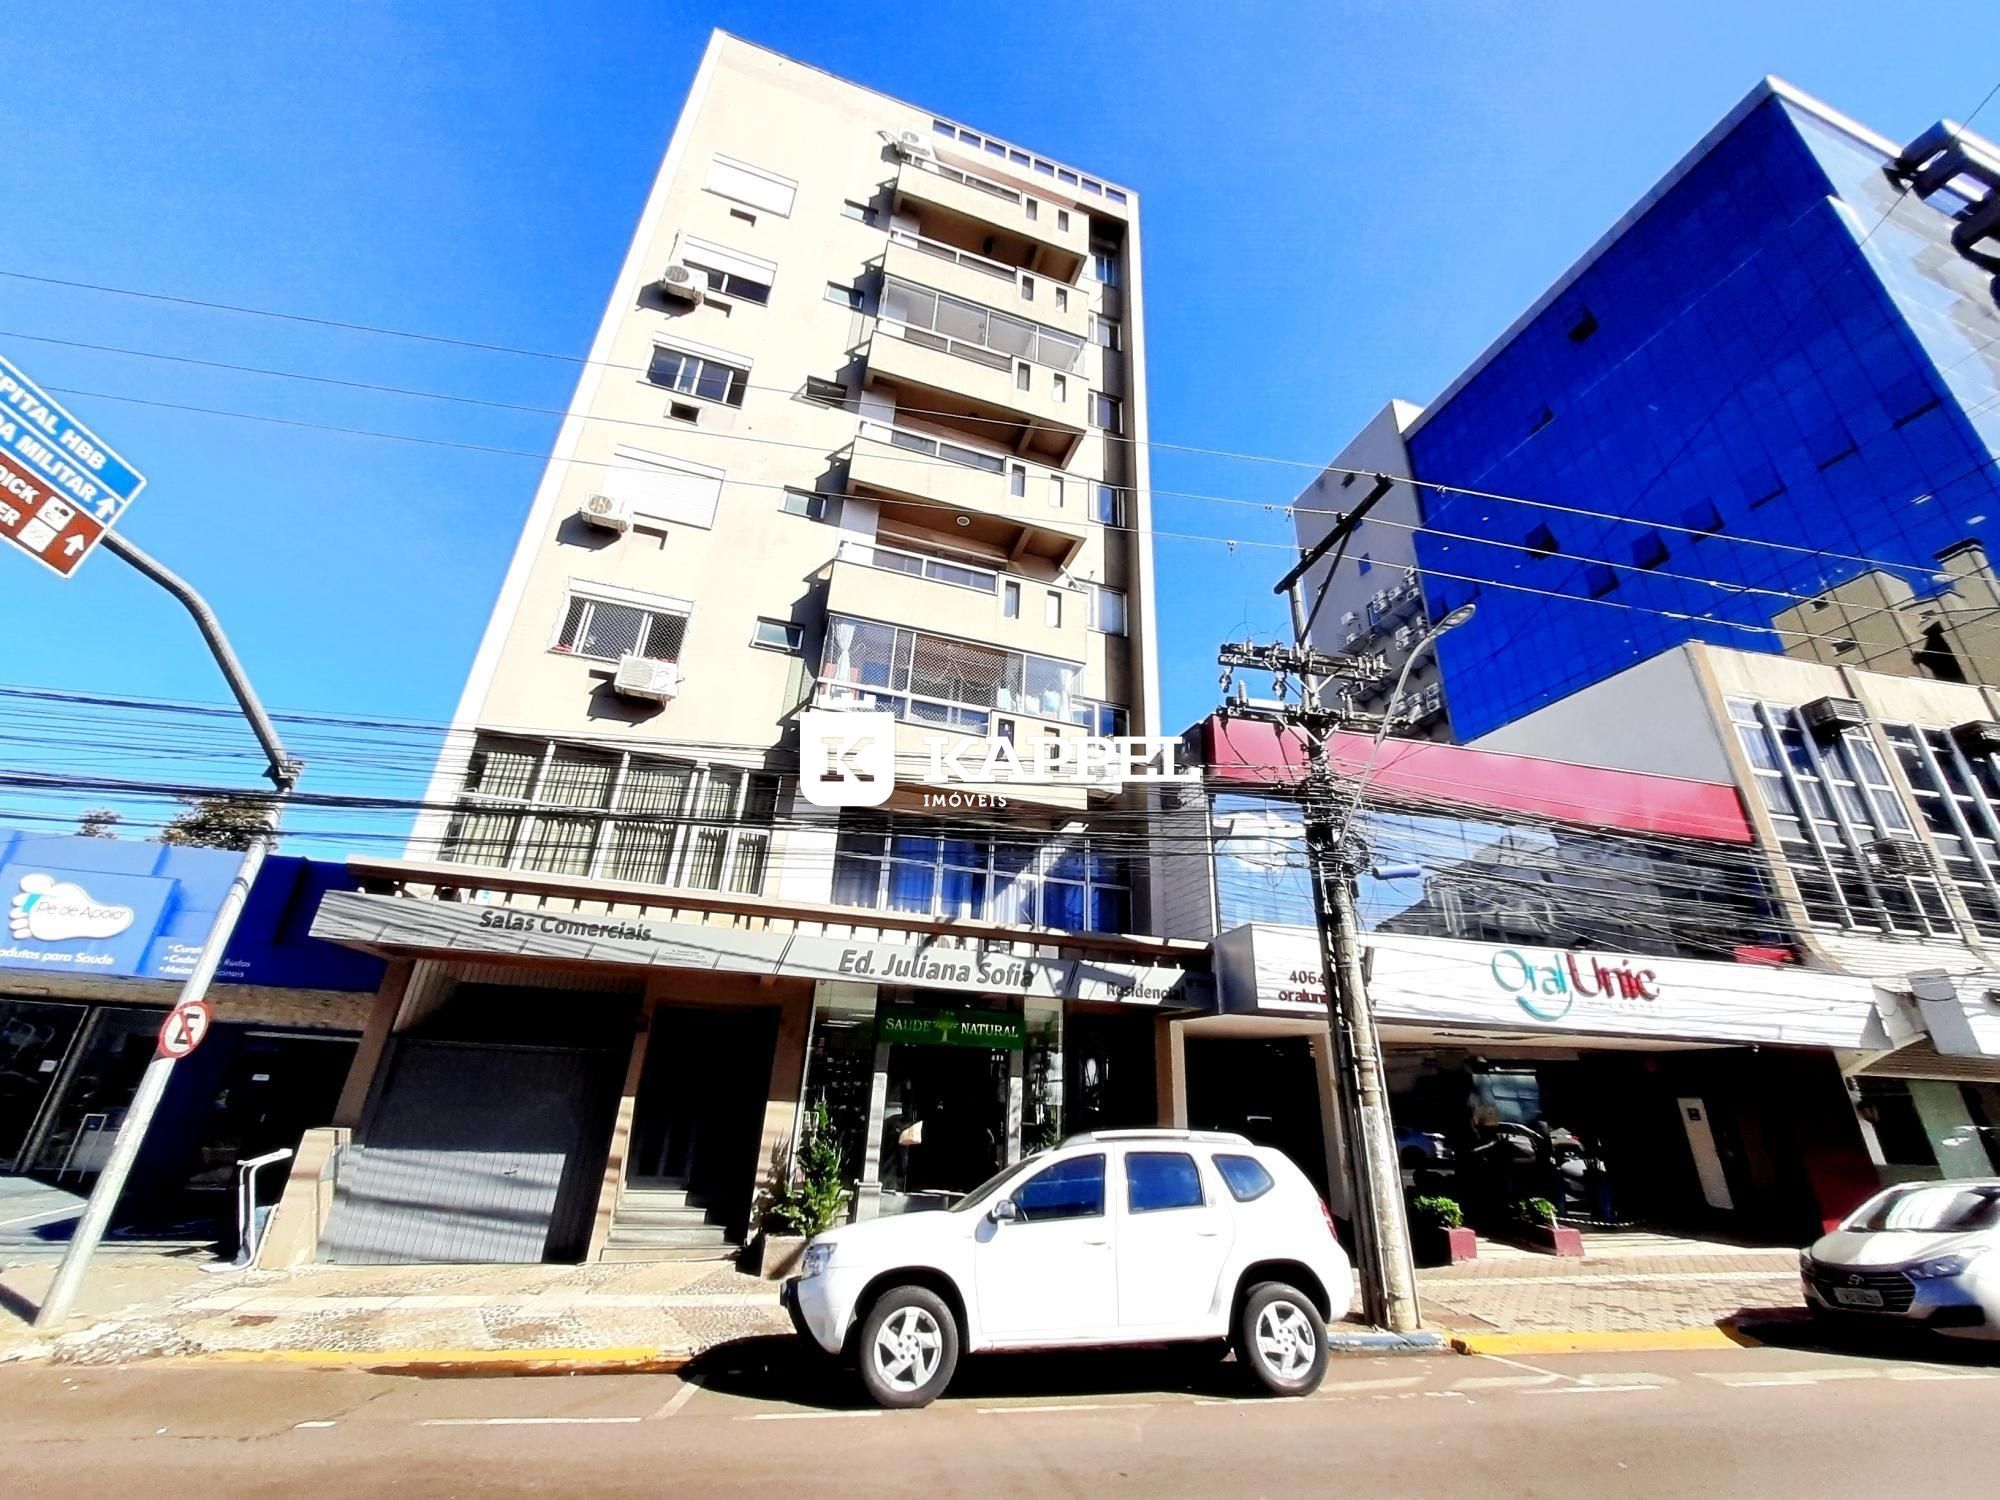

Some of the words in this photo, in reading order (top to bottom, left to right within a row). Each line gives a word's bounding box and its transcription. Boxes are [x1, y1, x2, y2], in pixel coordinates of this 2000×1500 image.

[0, 369, 59, 435] PITAL
[59, 428, 107, 470] HBB
[15, 434, 97, 503] MILITAR
[479, 910, 535, 932] Salas
[540, 917, 653, 942] Comerciais
[41, 952, 72, 962] para
[838, 949, 875, 974] Ed.
[881, 952, 971, 982] Juliana
[976, 961, 1034, 987] Sofia
[1106, 982, 1187, 1001] Residencial
[885, 1017, 932, 1032] SAUDE
[960, 1022, 1019, 1038] NATURAL
